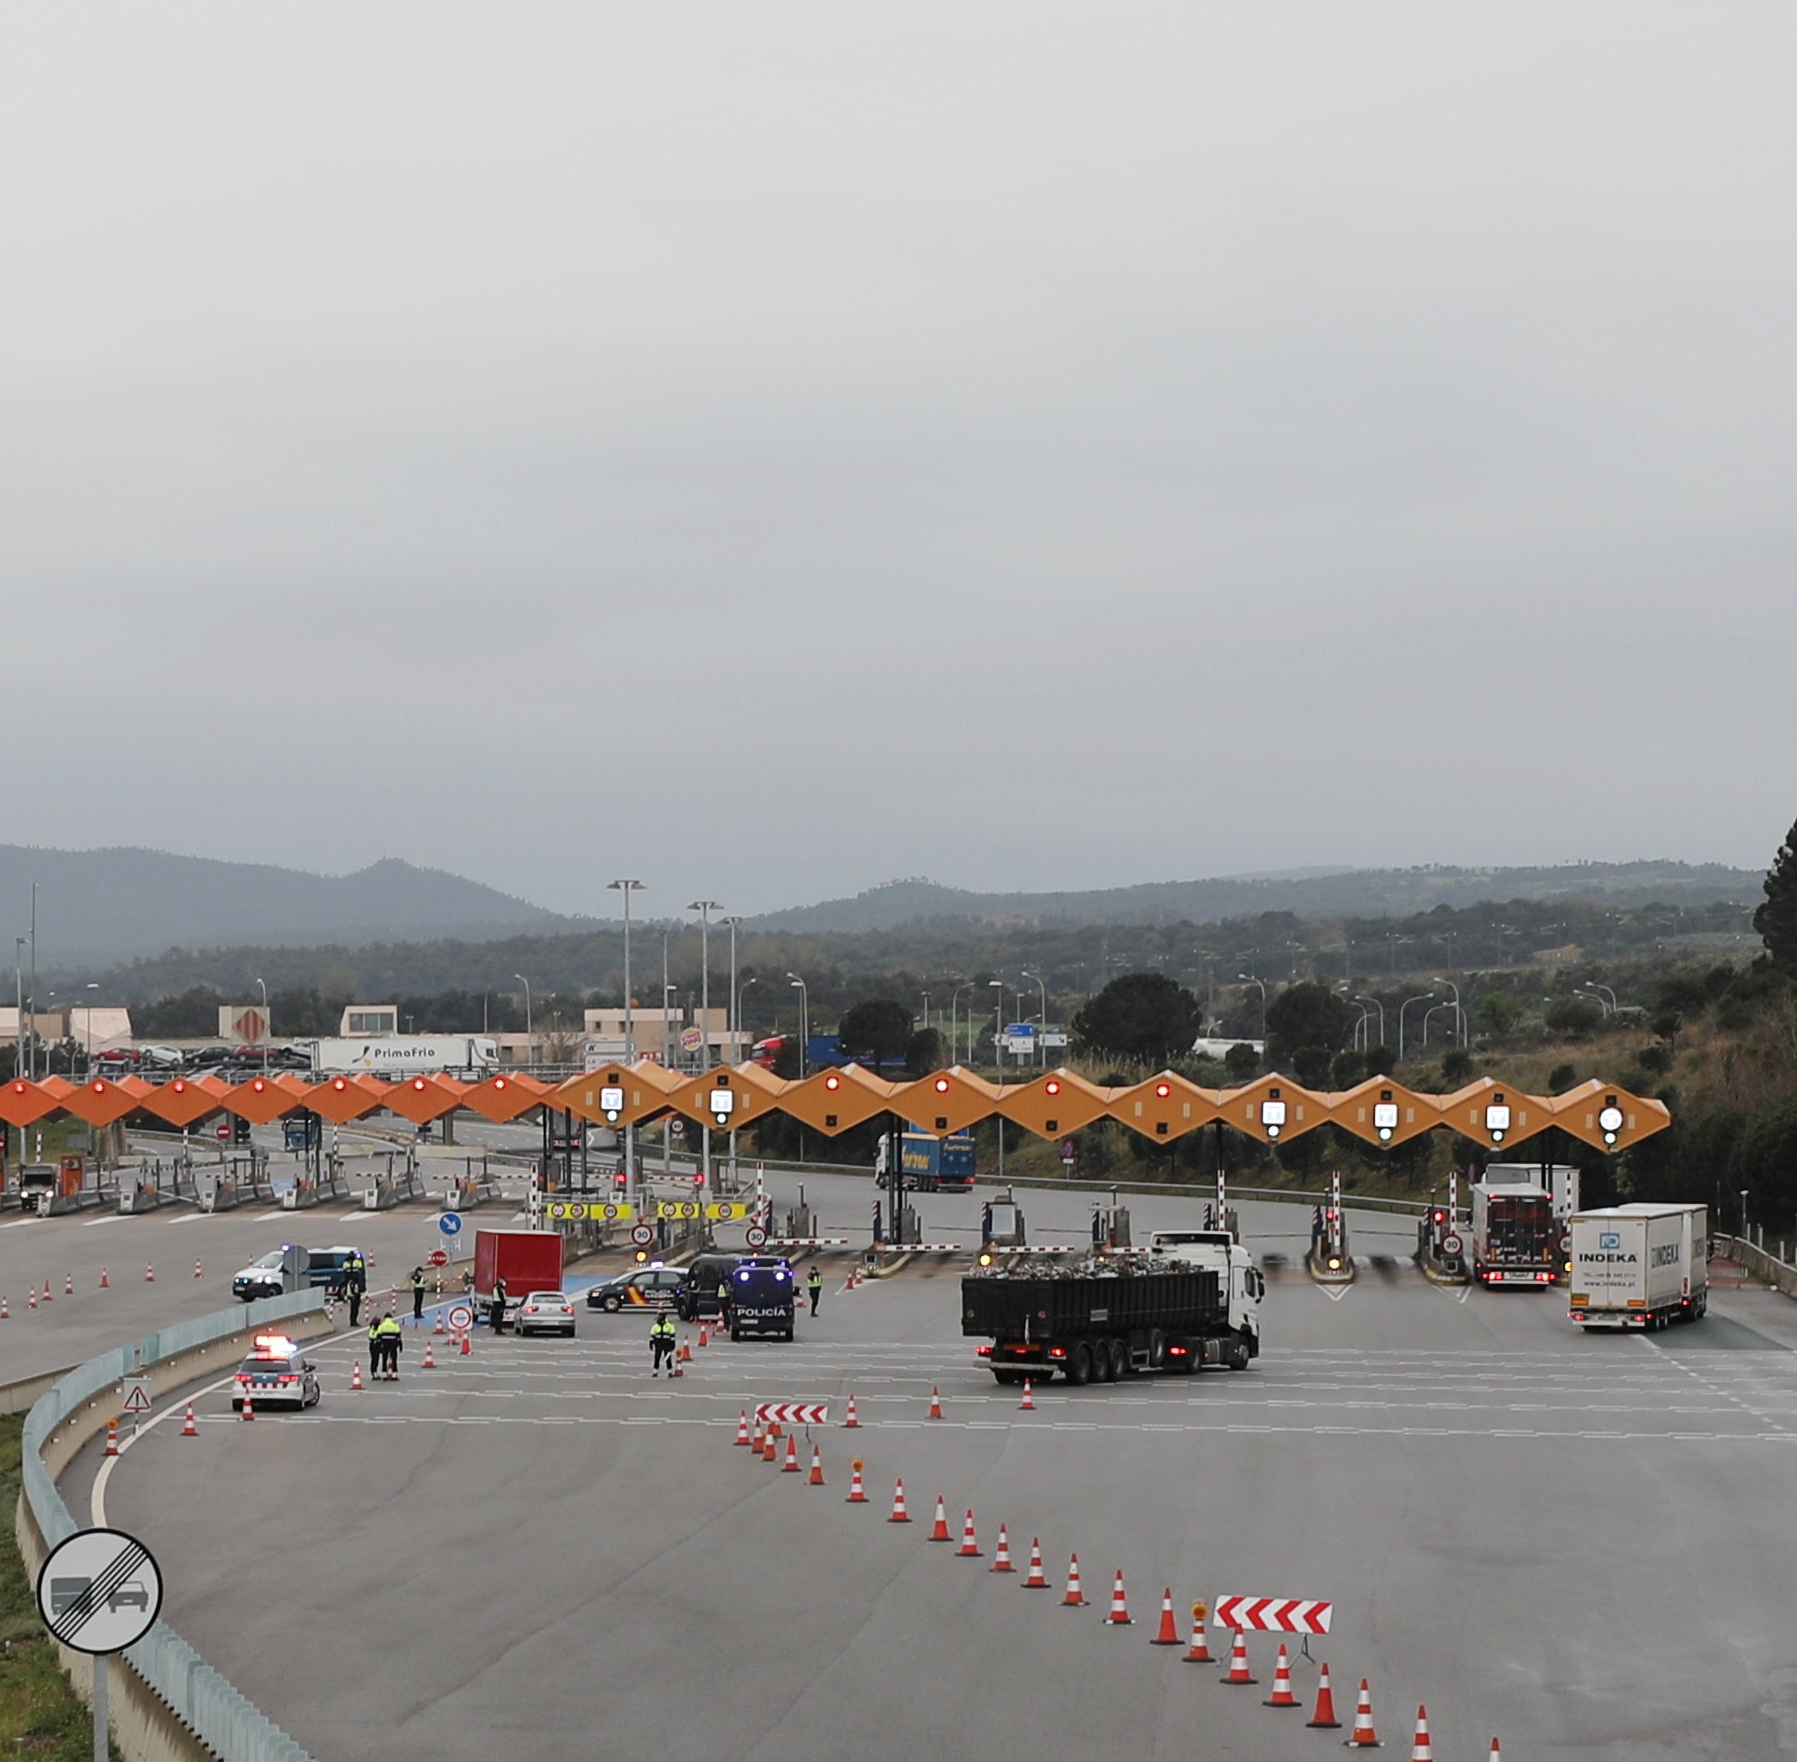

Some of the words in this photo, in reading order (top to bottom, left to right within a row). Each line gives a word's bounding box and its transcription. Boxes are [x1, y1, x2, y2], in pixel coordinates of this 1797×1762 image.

[374, 1046, 435, 1058] PrimaFrio
[636, 1230, 648, 1239] 30
[750, 1232, 762, 1241] 30
[1579, 1253, 1638, 1263] INDEKA
[737, 1307, 786, 1317] POLICÍA
